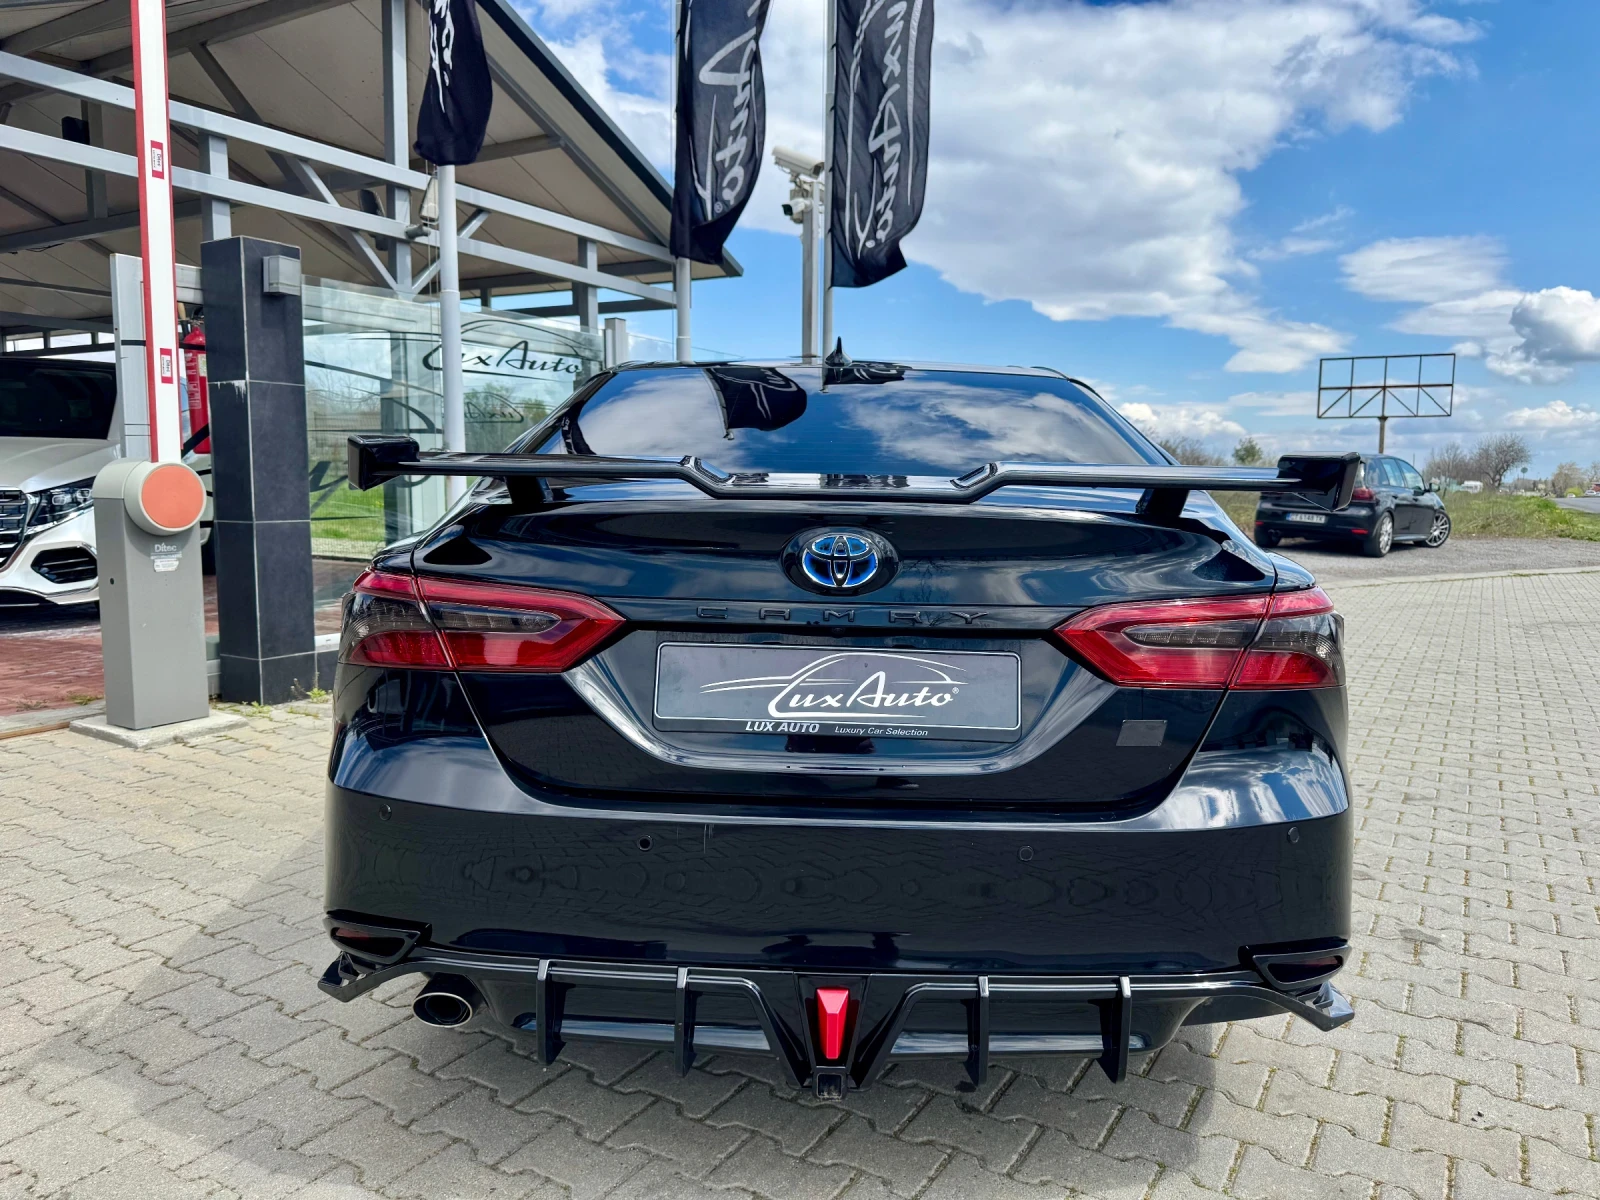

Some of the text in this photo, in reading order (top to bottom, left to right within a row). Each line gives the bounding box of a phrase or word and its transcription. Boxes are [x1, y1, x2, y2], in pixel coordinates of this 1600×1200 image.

[696, 606, 989, 624] CAMRY
[745, 721, 929, 736] LUX AUTO Luxury Car Selection
